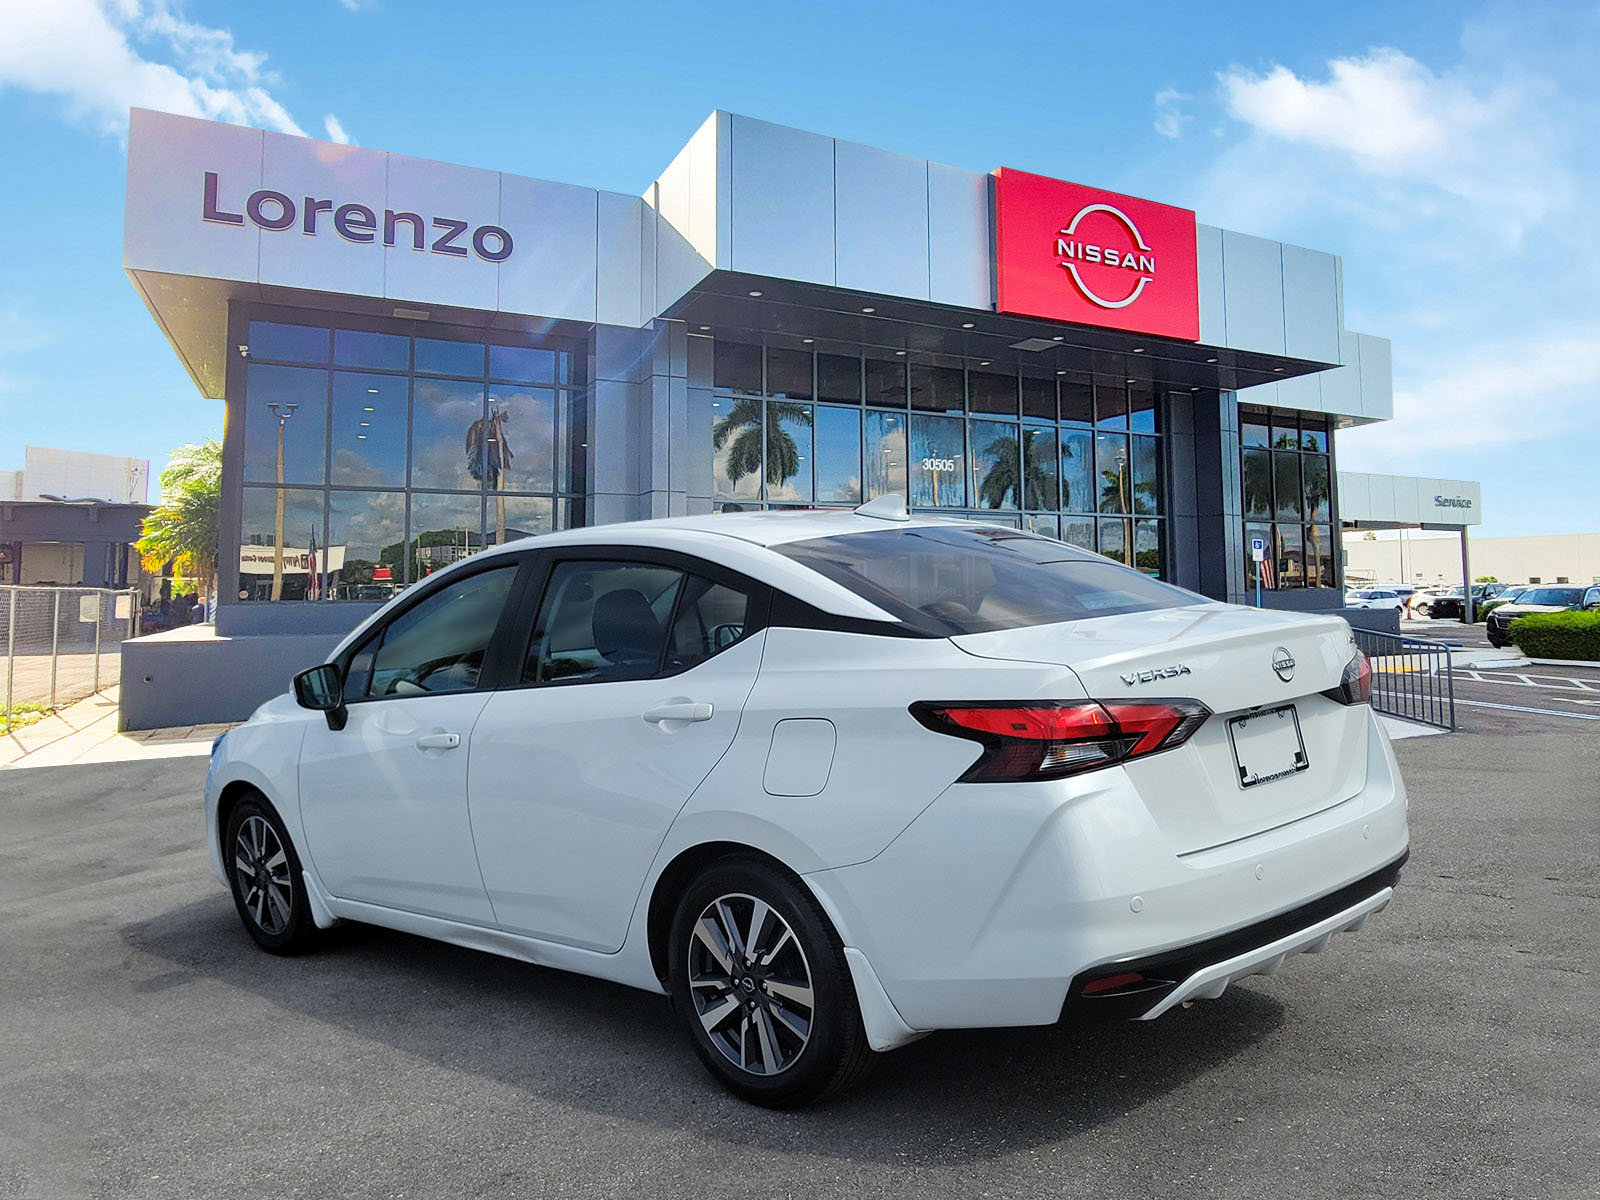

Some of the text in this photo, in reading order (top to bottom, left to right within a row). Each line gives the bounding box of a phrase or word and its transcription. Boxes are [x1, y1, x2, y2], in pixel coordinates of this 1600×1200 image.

[202, 171, 514, 262] Lorenzo
[1057, 238, 1156, 273] NISSAN
[922, 457, 955, 472] 30505
[1434, 495, 1472, 508] Service
[1120, 664, 1191, 686] VERSA
